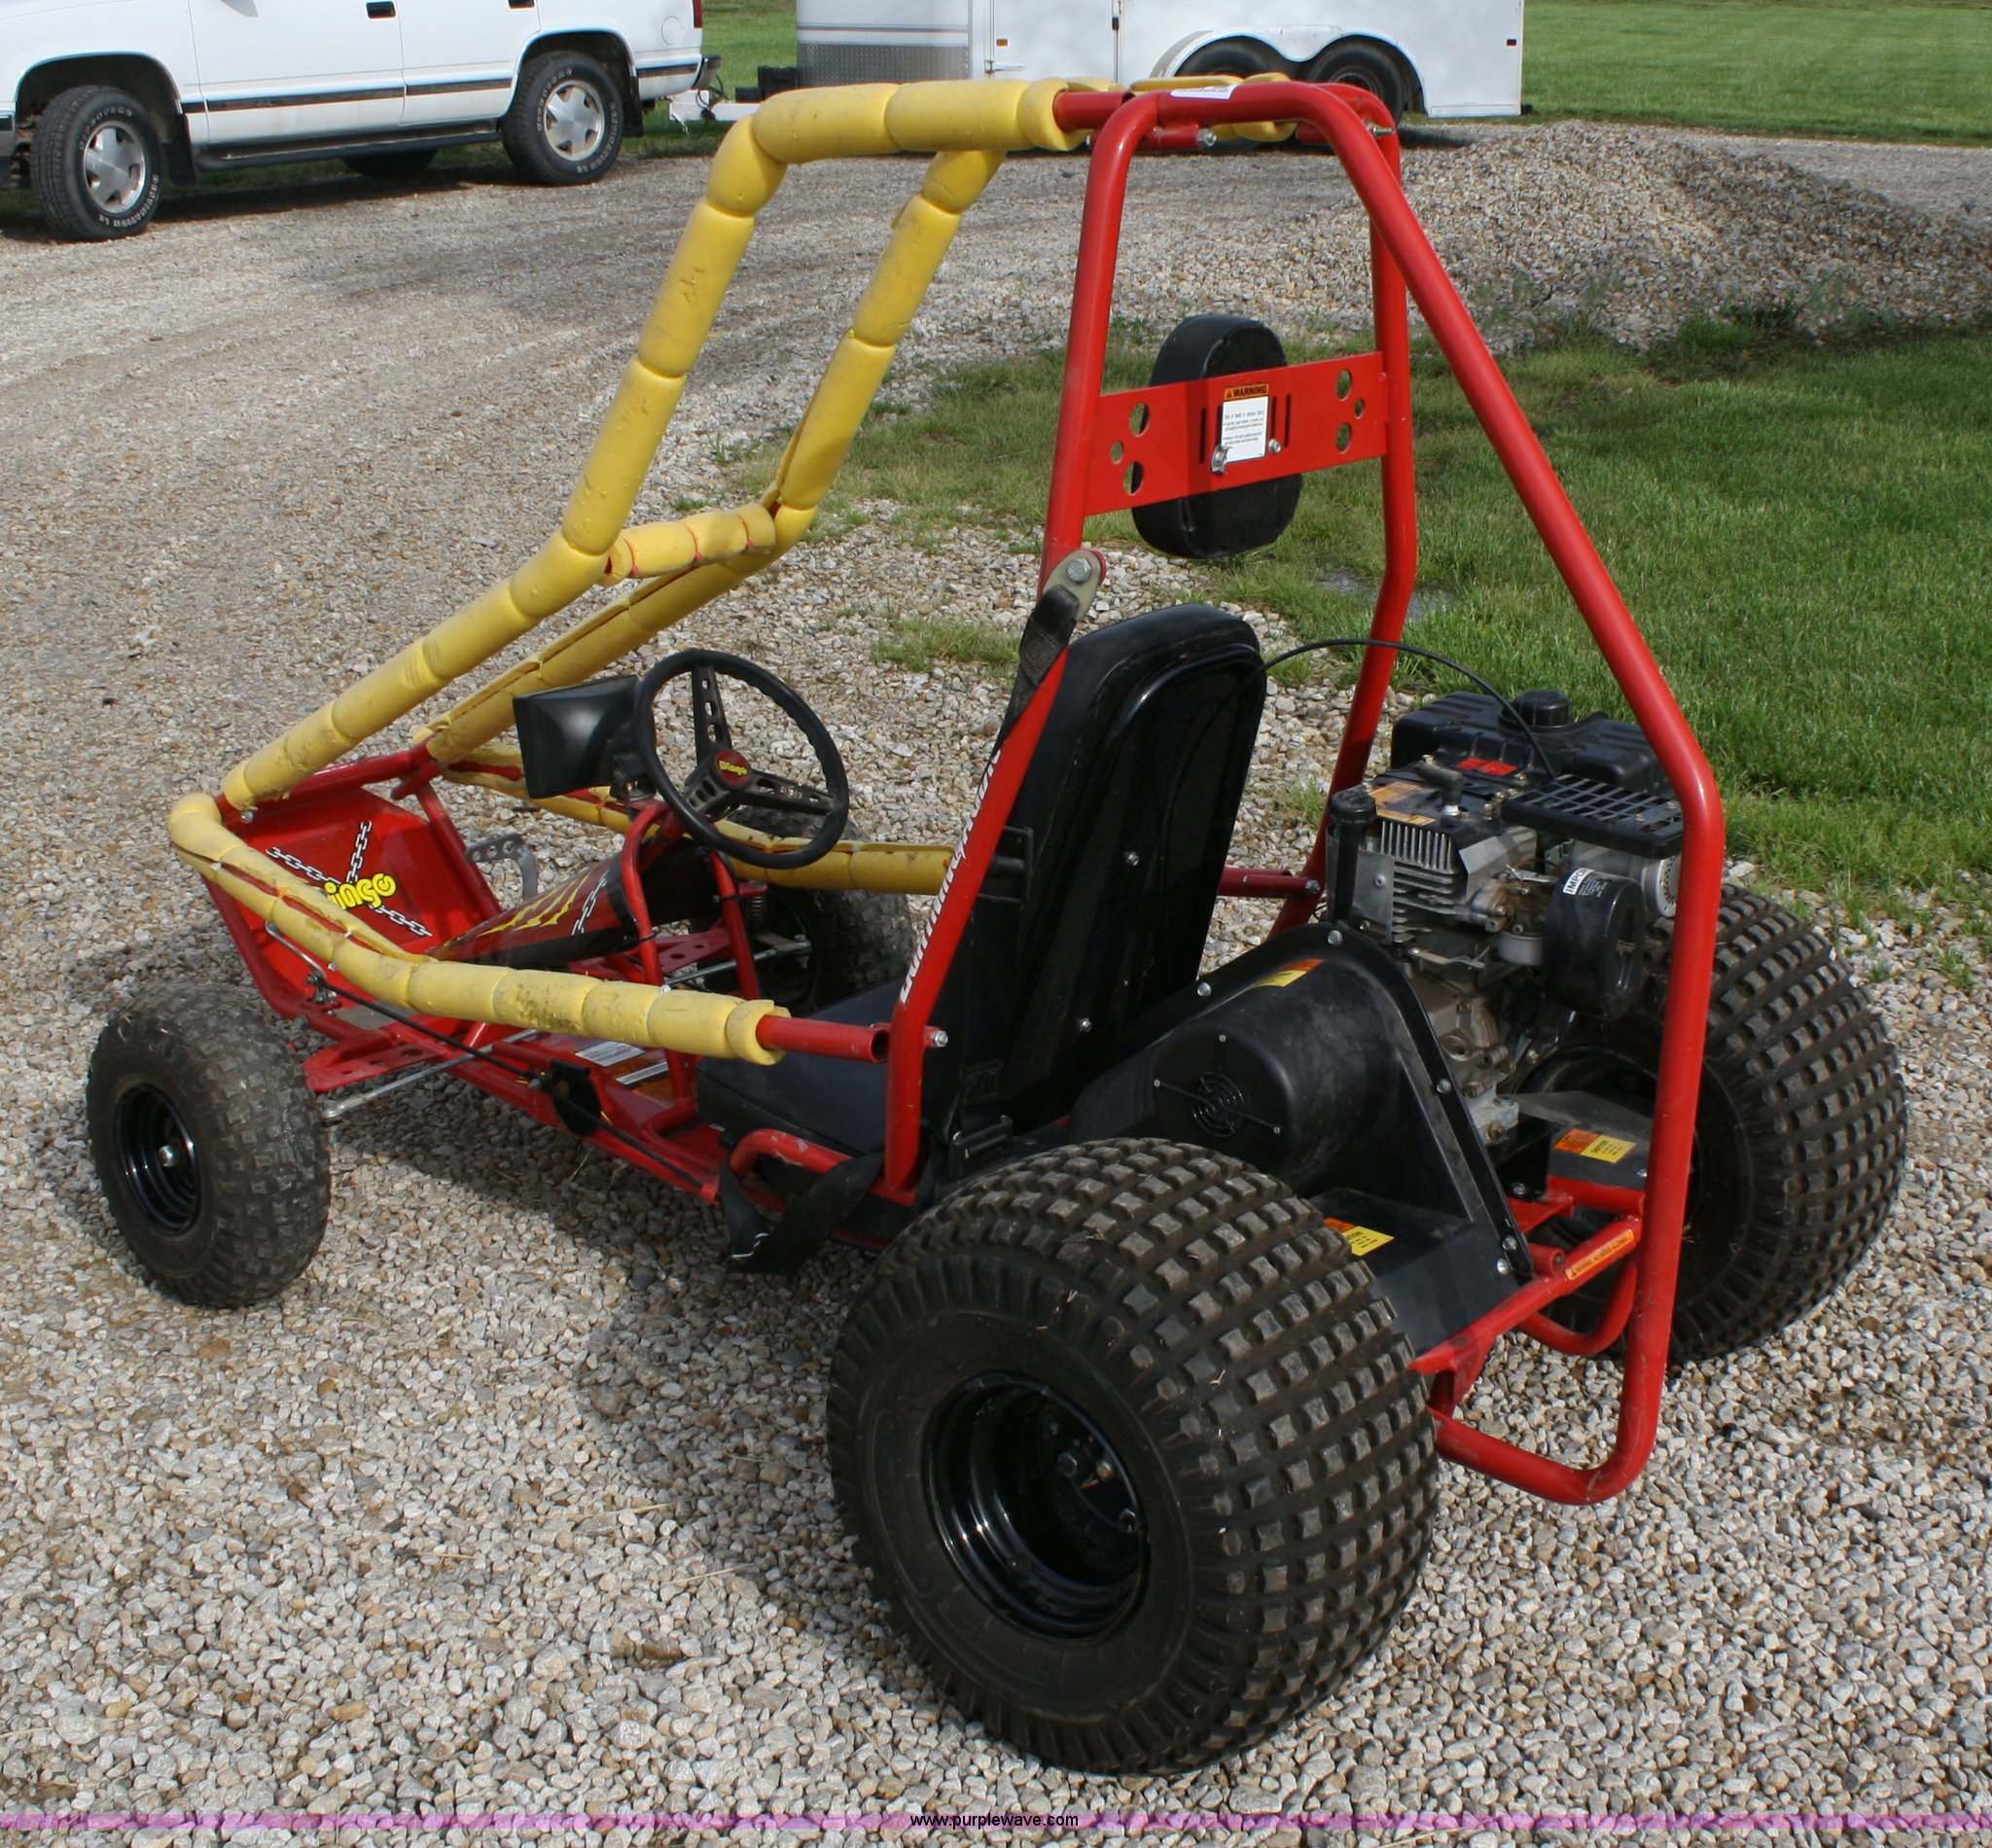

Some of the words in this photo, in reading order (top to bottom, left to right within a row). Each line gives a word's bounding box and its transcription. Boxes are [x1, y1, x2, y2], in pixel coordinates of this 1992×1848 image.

[1233, 385, 1267, 397] WARNING
[324, 872, 397, 910] ingo
[1565, 869, 1588, 893] IMPO
